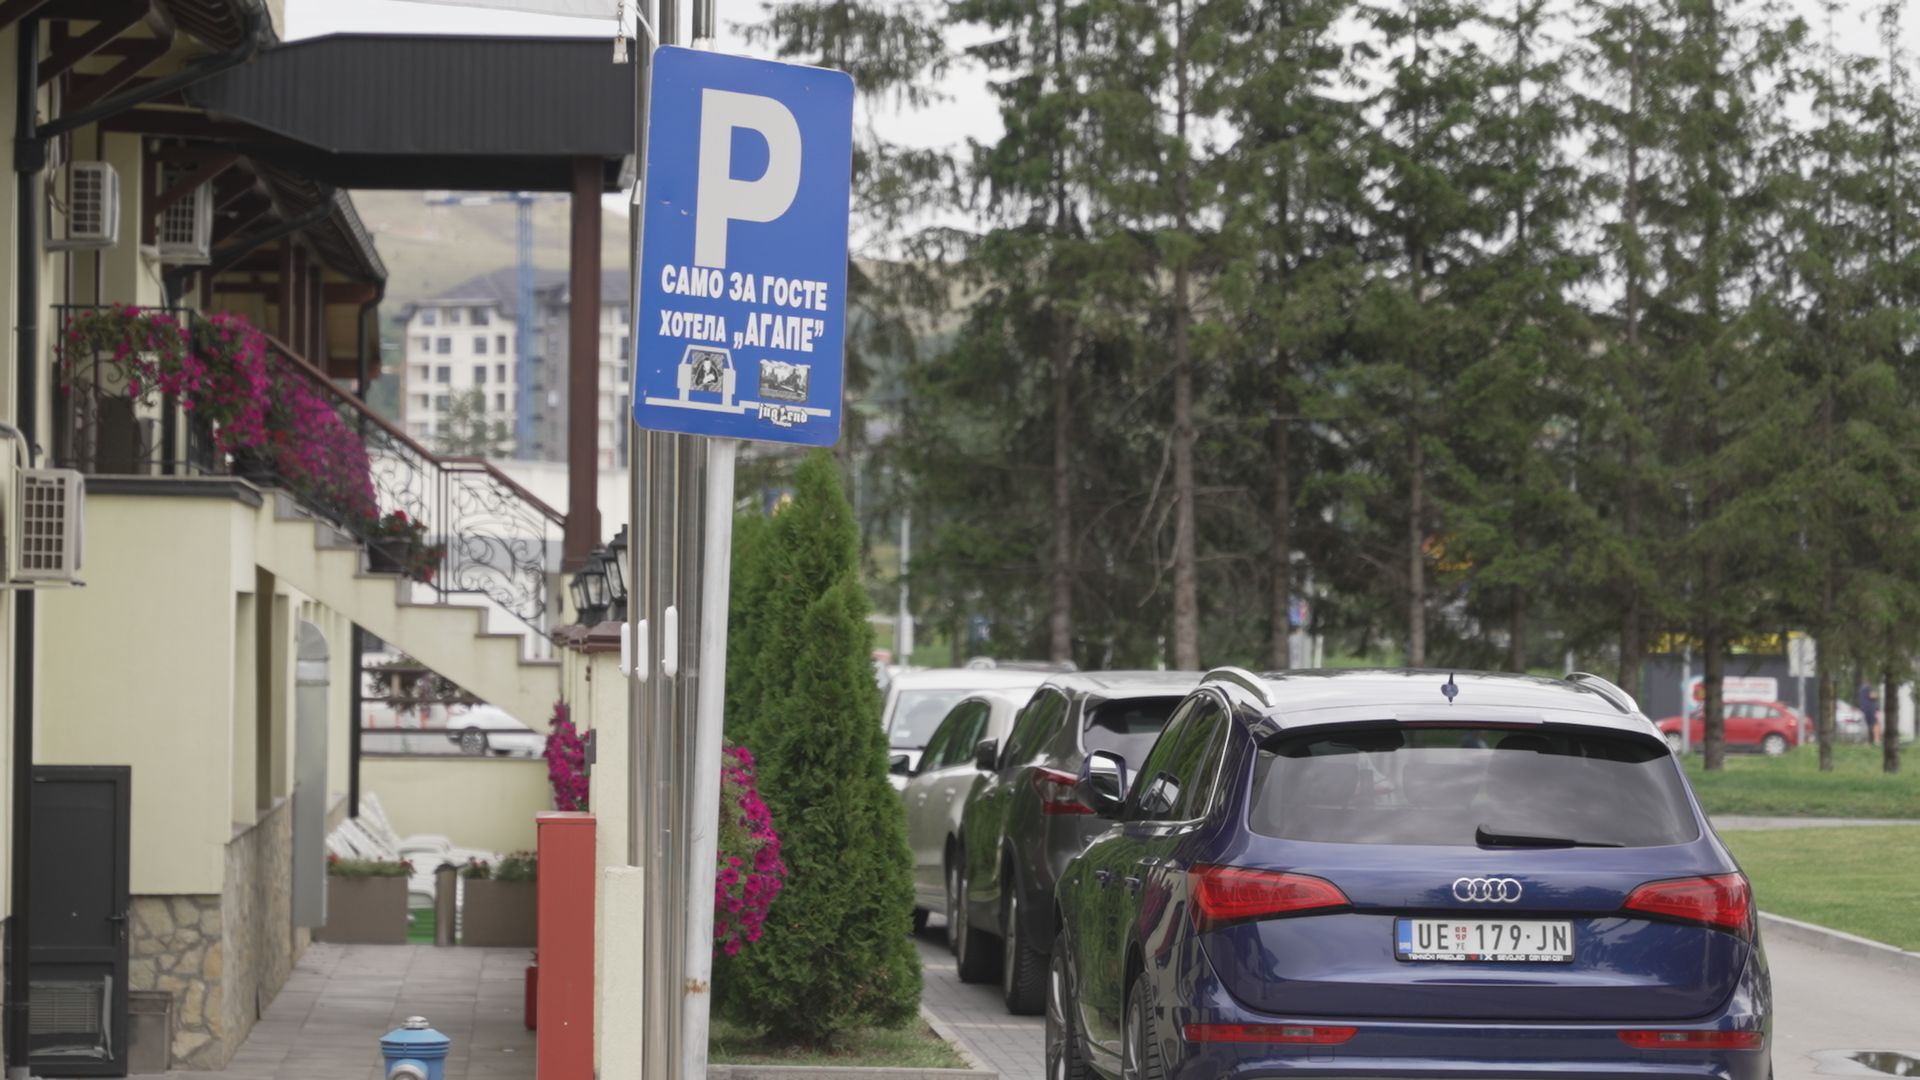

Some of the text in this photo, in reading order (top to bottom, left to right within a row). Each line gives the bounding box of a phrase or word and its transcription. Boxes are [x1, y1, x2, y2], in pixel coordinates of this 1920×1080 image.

[694, 87, 802, 269] P
[661, 264, 828, 311] САМО ЗА ГОСТЕ
[658, 309, 726, 343] ХОТЕЛА
[1418, 923, 1449, 950] UE
